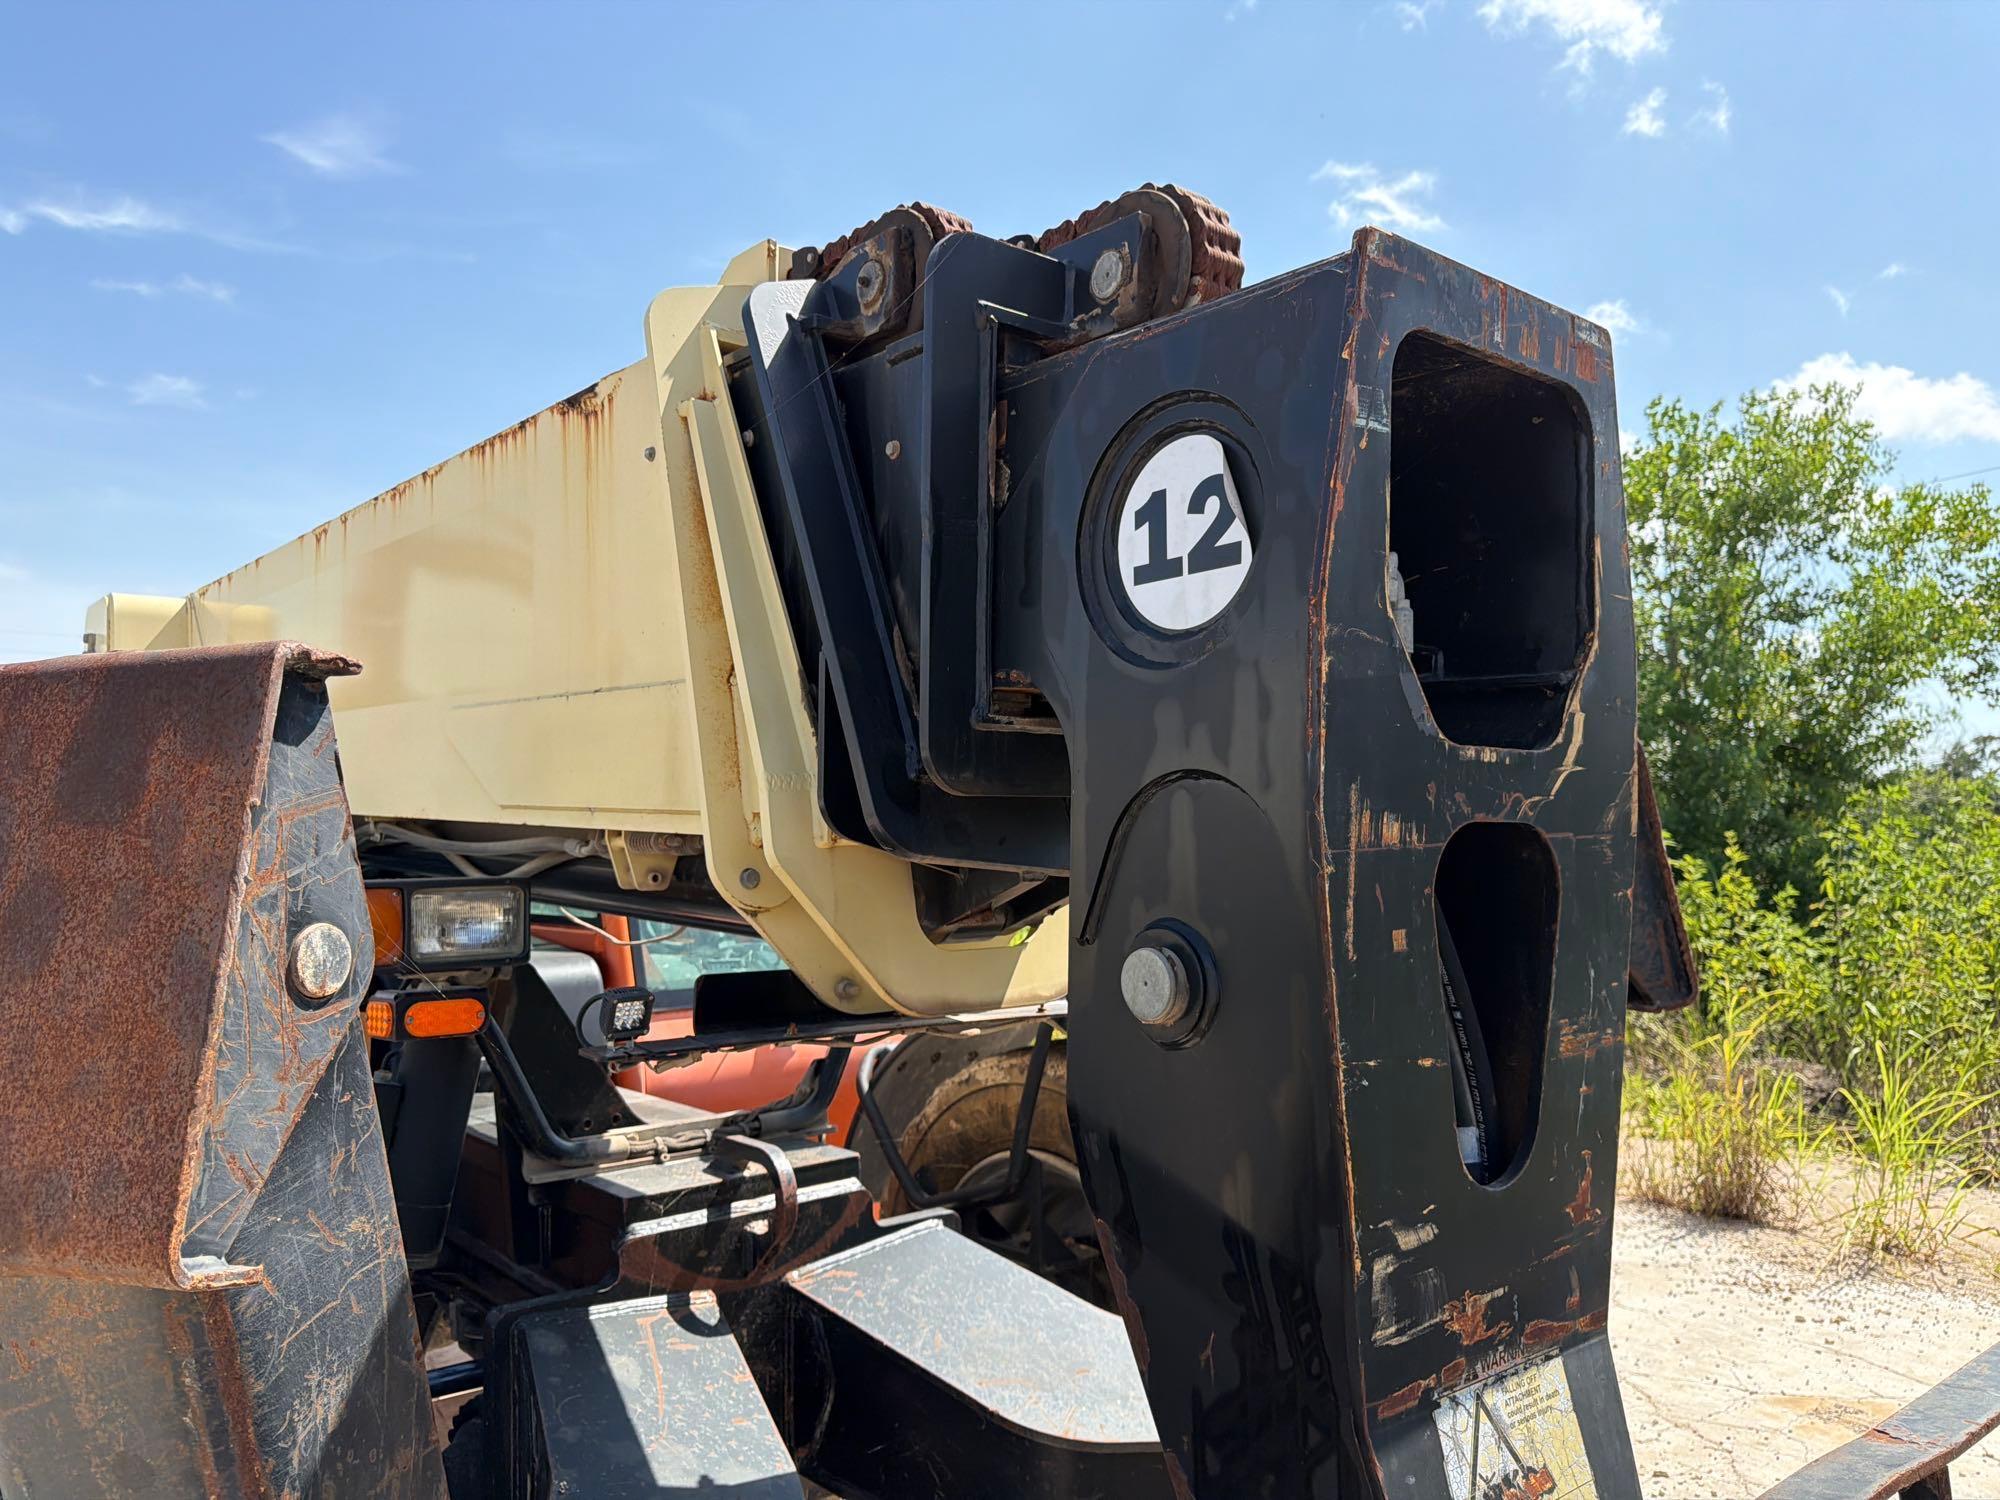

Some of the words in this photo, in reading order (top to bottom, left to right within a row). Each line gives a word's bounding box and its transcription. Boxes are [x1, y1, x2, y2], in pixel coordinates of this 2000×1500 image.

[1133, 473, 1242, 586] 12
[1481, 1347, 1526, 1373] WARNIN
[1501, 1378, 1526, 1395] FALLING
[1526, 1373, 1537, 1385] OFF
[1504, 1384, 1542, 1407] ATTACHMENT
[1507, 1404, 1522, 1419] could
